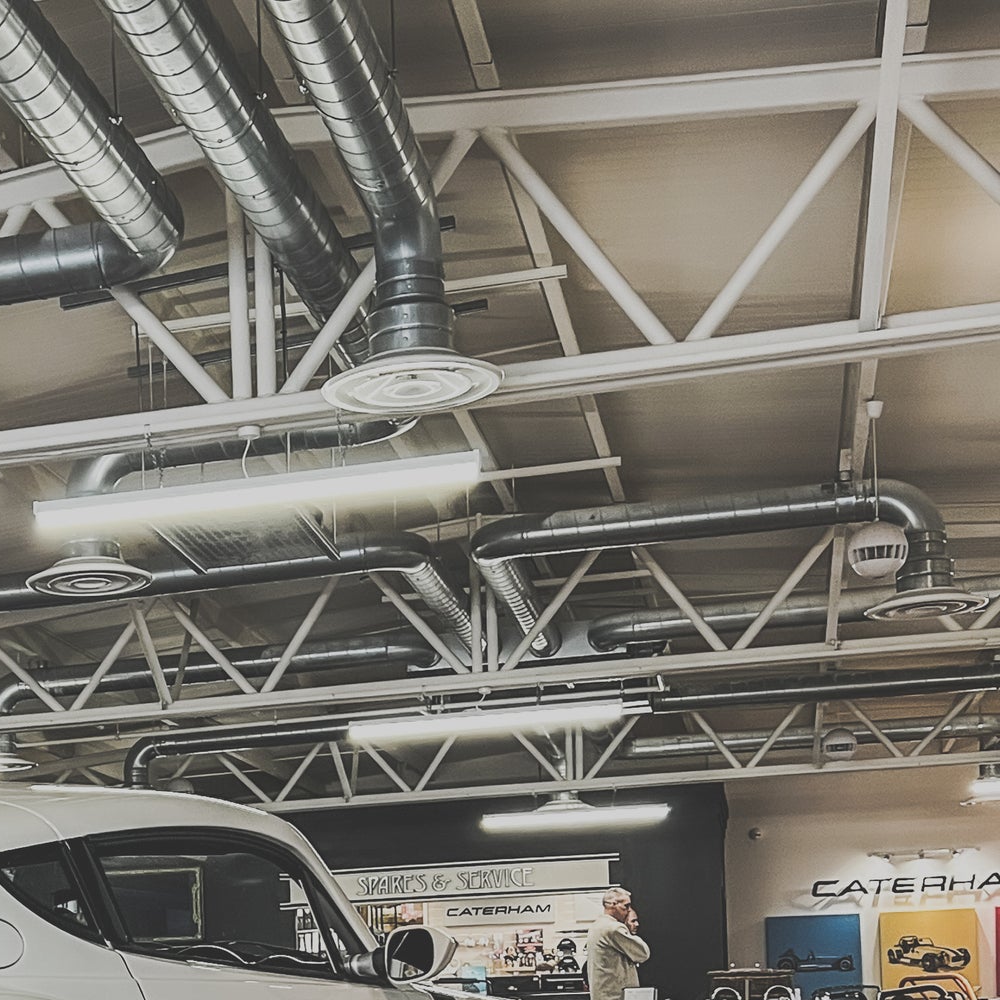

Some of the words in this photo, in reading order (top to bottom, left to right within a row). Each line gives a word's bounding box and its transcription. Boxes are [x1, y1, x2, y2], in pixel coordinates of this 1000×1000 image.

[356, 873, 428, 896] SPARES
[432, 873, 451, 892] &
[455, 867, 535, 891] SERVICE
[446, 904, 551, 917] CATERHAM
